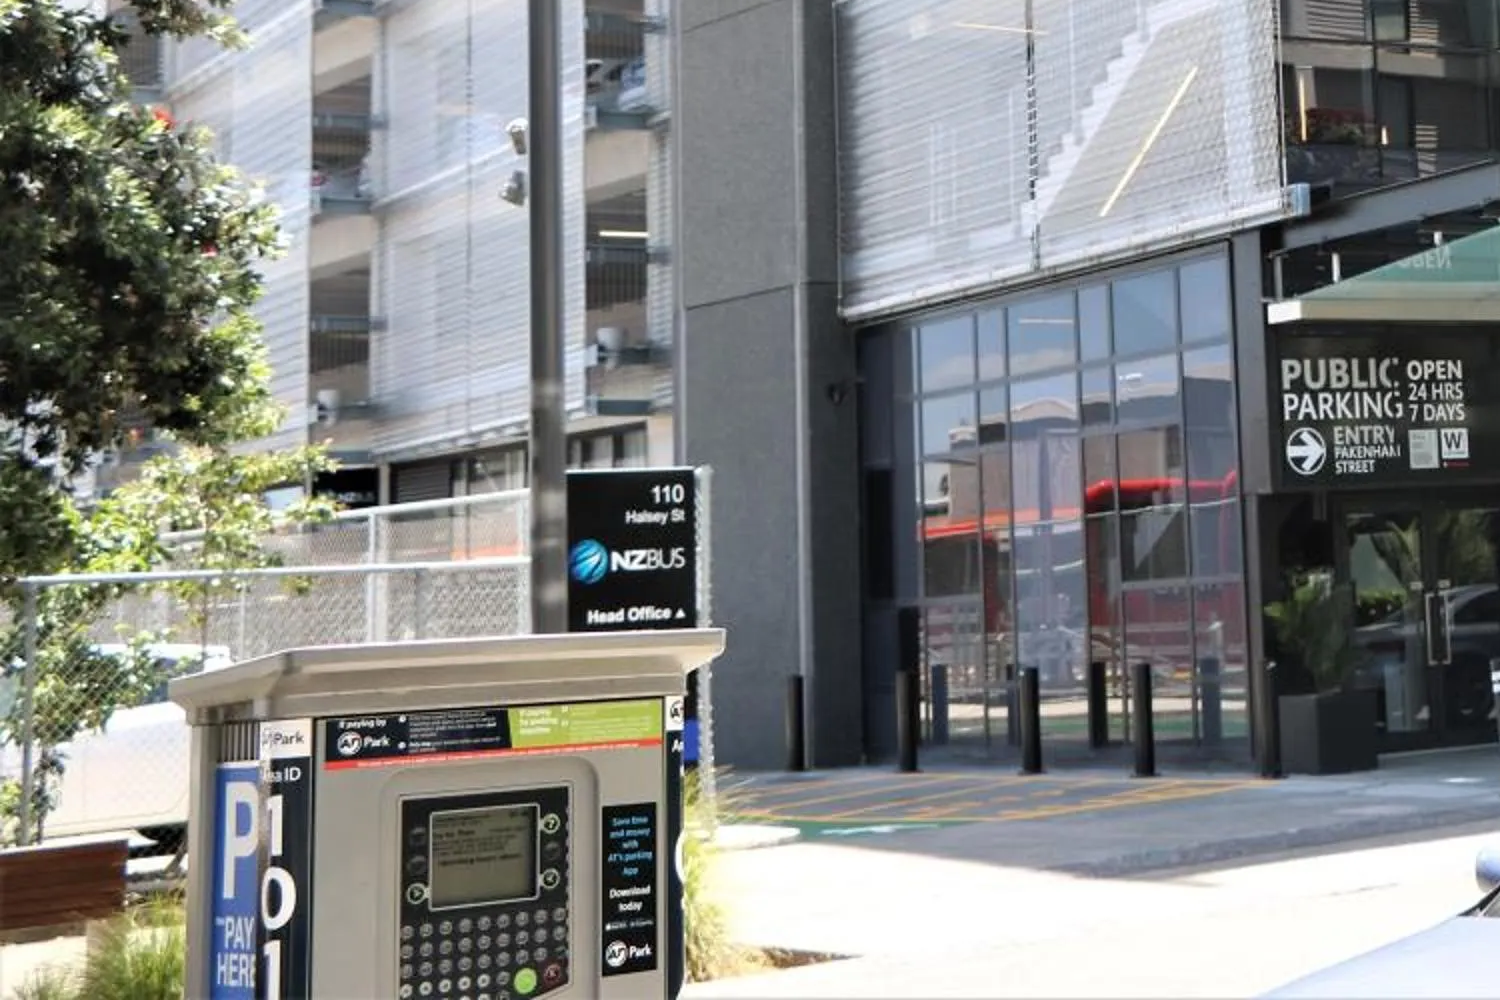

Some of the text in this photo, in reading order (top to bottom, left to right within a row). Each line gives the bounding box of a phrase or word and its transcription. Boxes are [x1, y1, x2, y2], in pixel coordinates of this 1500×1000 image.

[1281, 357, 1399, 390] PUBLIC
[1407, 360, 1463, 381] OPEN
[1408, 382, 1464, 401] 24 HRS
[1283, 390, 1403, 421] PARKING
[1408, 403, 1466, 422] 7 DAYS
[1333, 424, 1396, 445] ENTRY
[1335, 459, 1376, 474] STREET
[651, 484, 685, 503] 110
[625, 509, 685, 525] Halsey St
[611, 548, 686, 571] NZBUS
[587, 606, 672, 625] Head Office
[272, 730, 304, 745] Park
[363, 736, 390, 748] Park
[284, 767, 301, 781] ID
[223, 781, 259, 899] P
[609, 885, 651, 899] Download
[618, 901, 643, 912] today
[224, 916, 254, 949] PAY
[628, 945, 652, 960] Park
